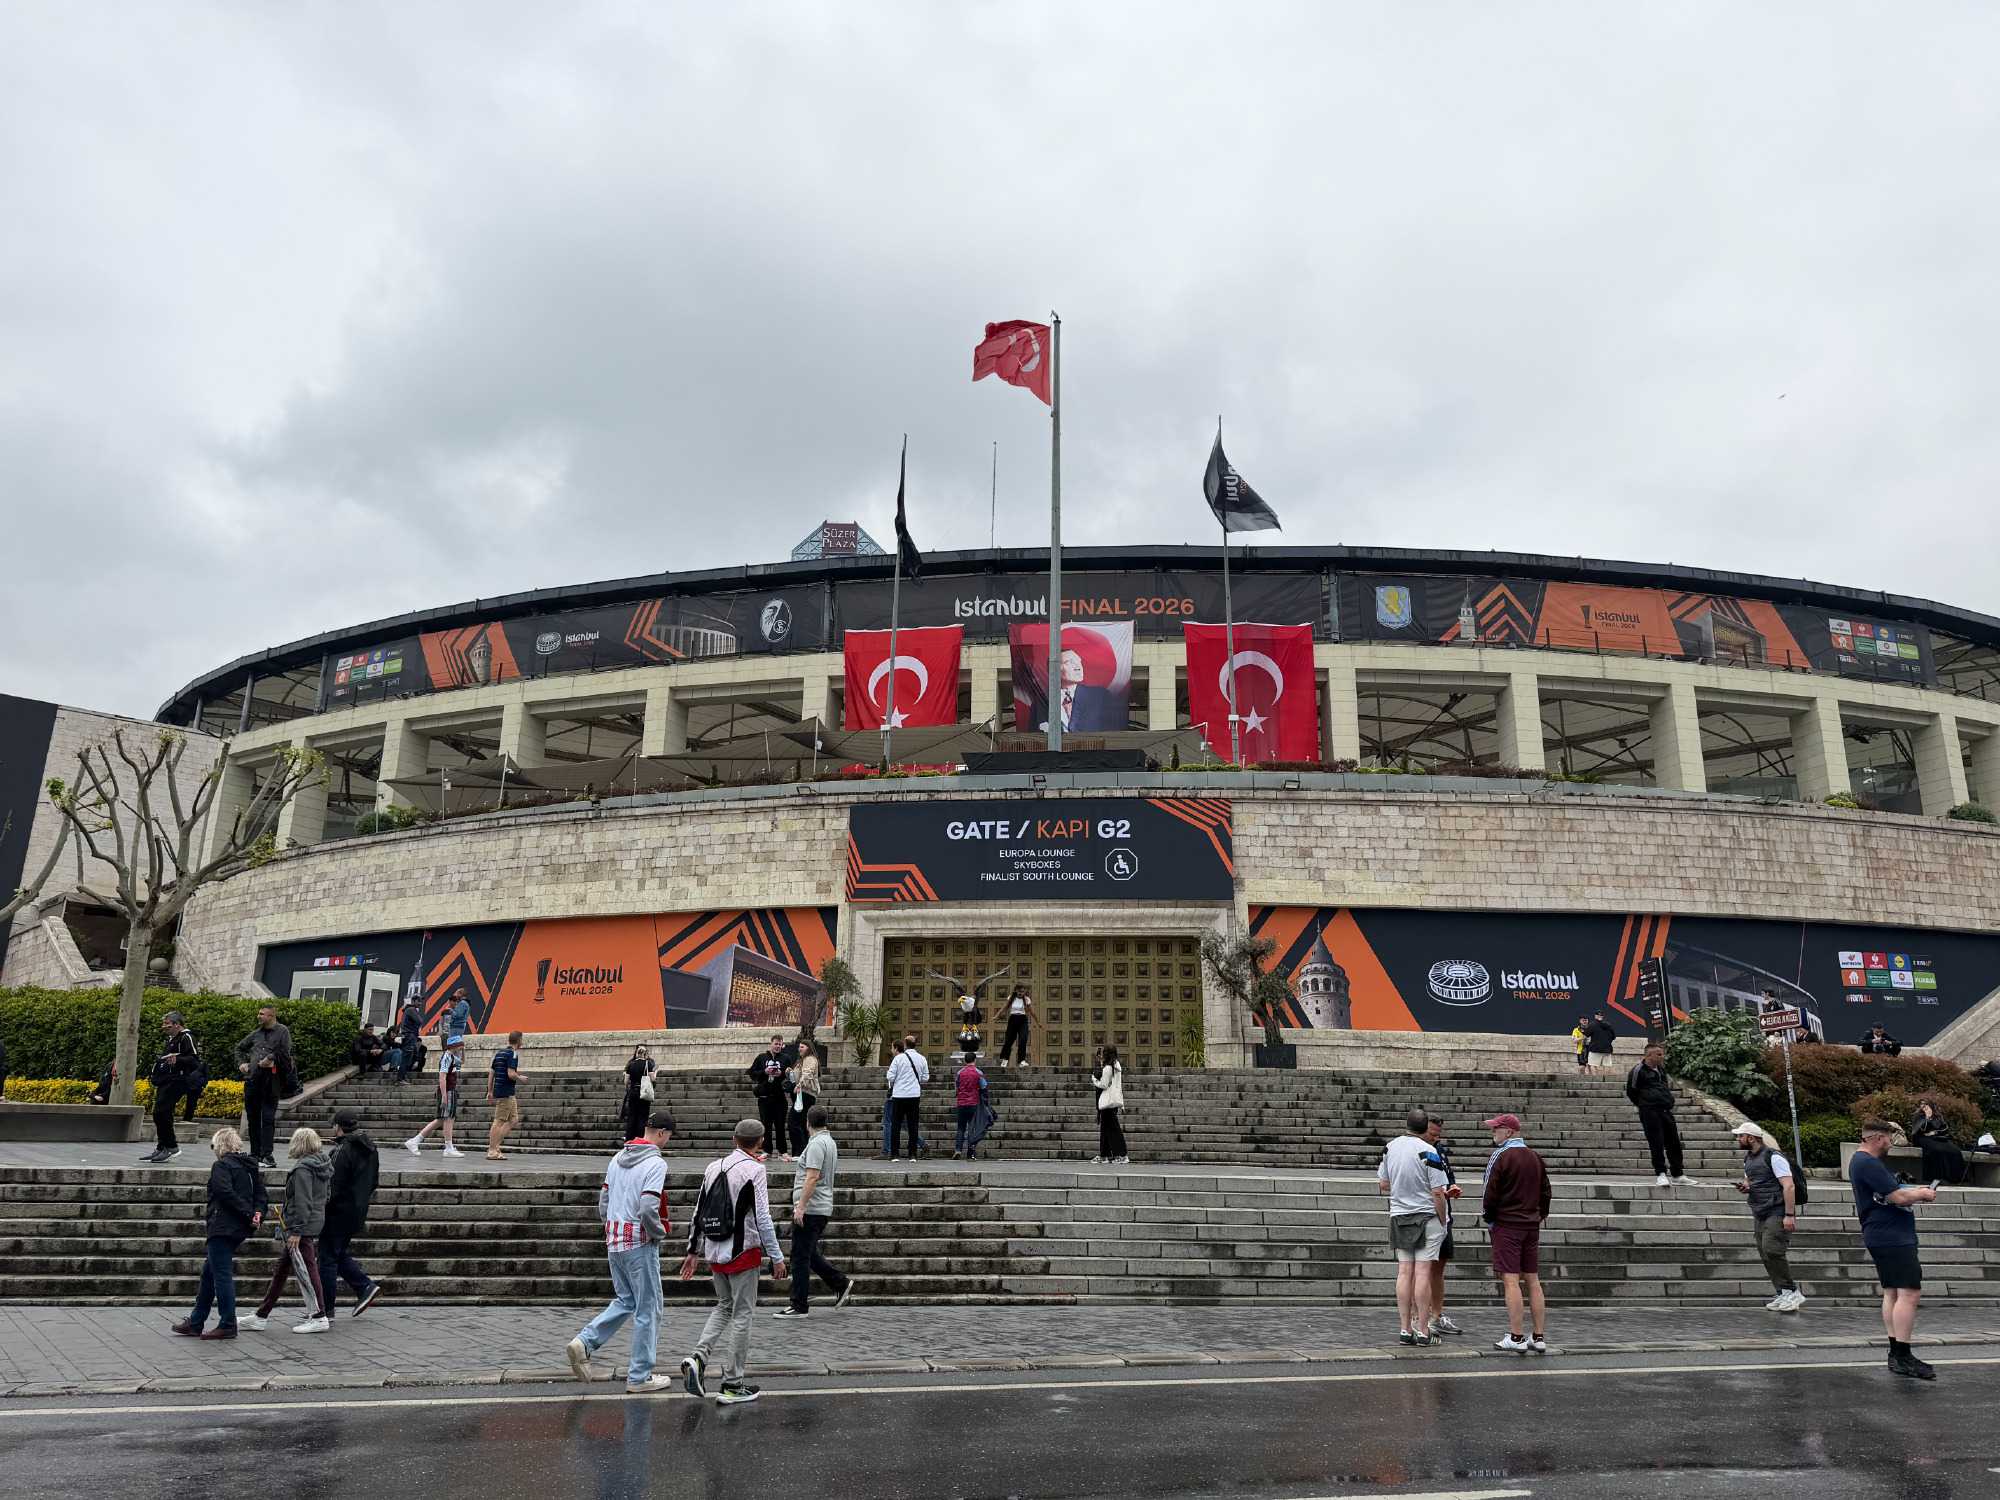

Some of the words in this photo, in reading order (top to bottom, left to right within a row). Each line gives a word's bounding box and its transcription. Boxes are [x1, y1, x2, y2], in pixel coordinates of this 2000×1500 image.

[823, 527, 856, 539] SÜZER
[822, 537, 856, 548] PLAZA
[954, 595, 1048, 617] Istanbul
[1060, 598, 1127, 615] FINAL
[1134, 597, 1195, 615] 2026
[1594, 610, 1641, 624] Istanbul
[565, 631, 599, 643] Istanbul
[947, 820, 1010, 840] GATE
[1016, 820, 1031, 839] /
[1037, 819, 1090, 839] KAPI
[1097, 819, 1131, 839] G2
[999, 848, 1036, 858] EUROPA
[1038, 848, 1076, 858] LOUNGE
[1013, 860, 1061, 870] SKYBOXES
[980, 872, 1020, 882] FINALIST
[1022, 872, 1053, 882] SOUTH
[1055, 872, 1095, 881] LOUNGE
[554, 964, 623, 984] Istanbul
[1500, 969, 1580, 990] Istanbul
[560, 987, 587, 996] FINAL
[589, 986, 613, 995] 2026
[1513, 991, 1544, 1000] FINAL
[1544, 991, 1571, 1000] 2026
